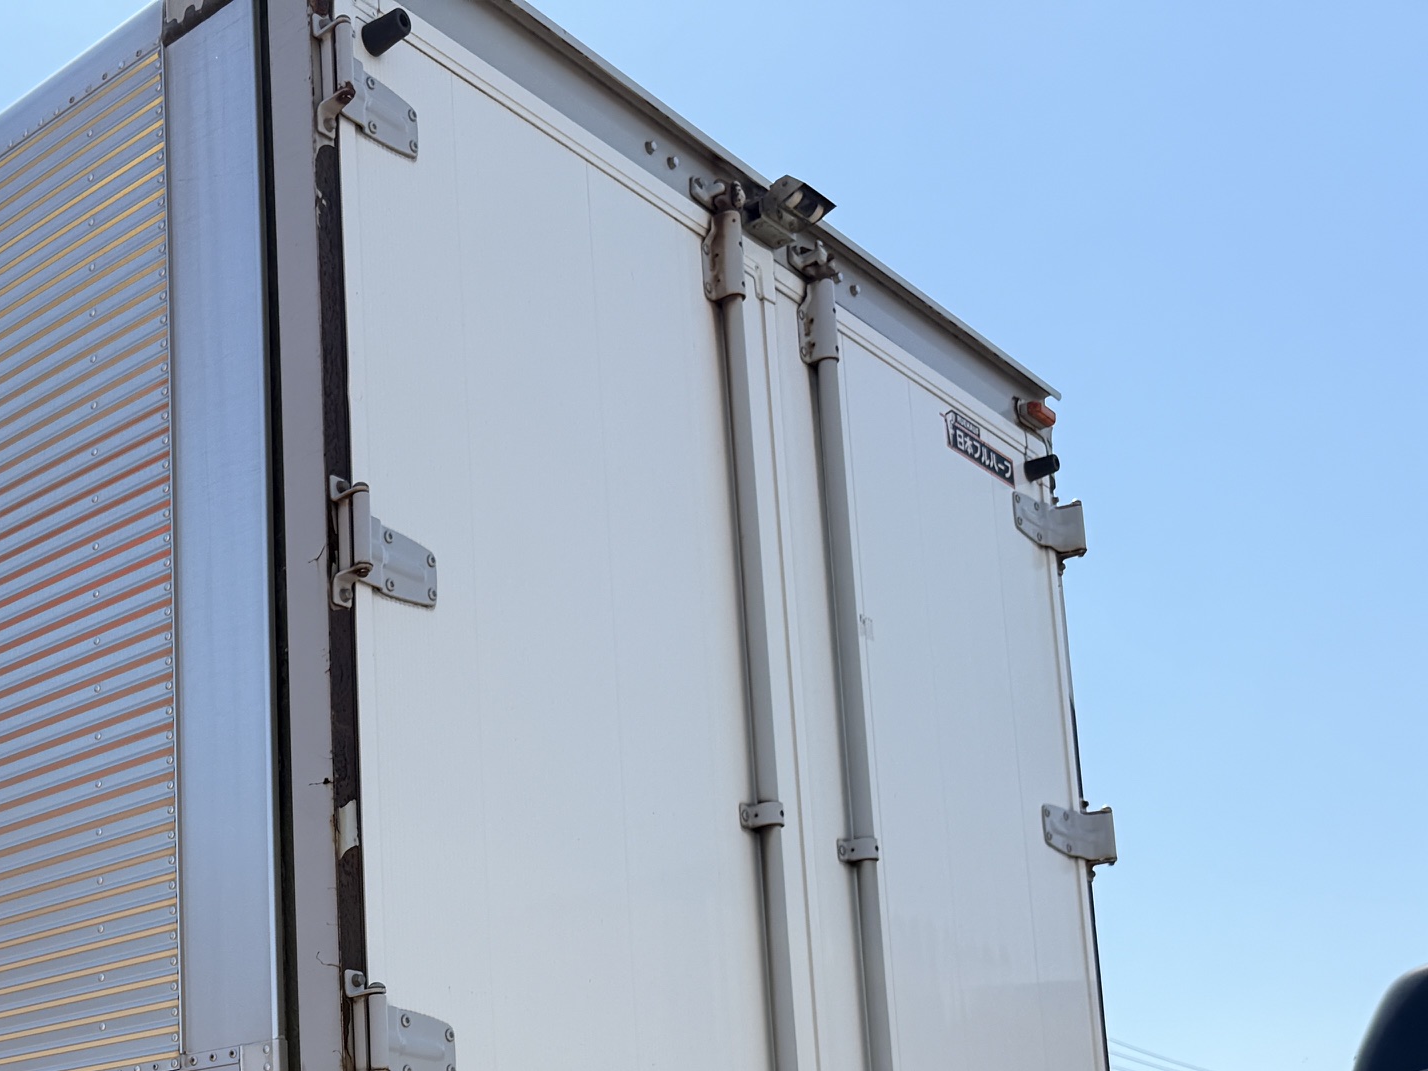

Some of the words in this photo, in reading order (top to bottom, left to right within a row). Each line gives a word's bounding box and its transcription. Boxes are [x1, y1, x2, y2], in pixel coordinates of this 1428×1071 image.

[956, 429, 1012, 478] 日本フルハーフ
